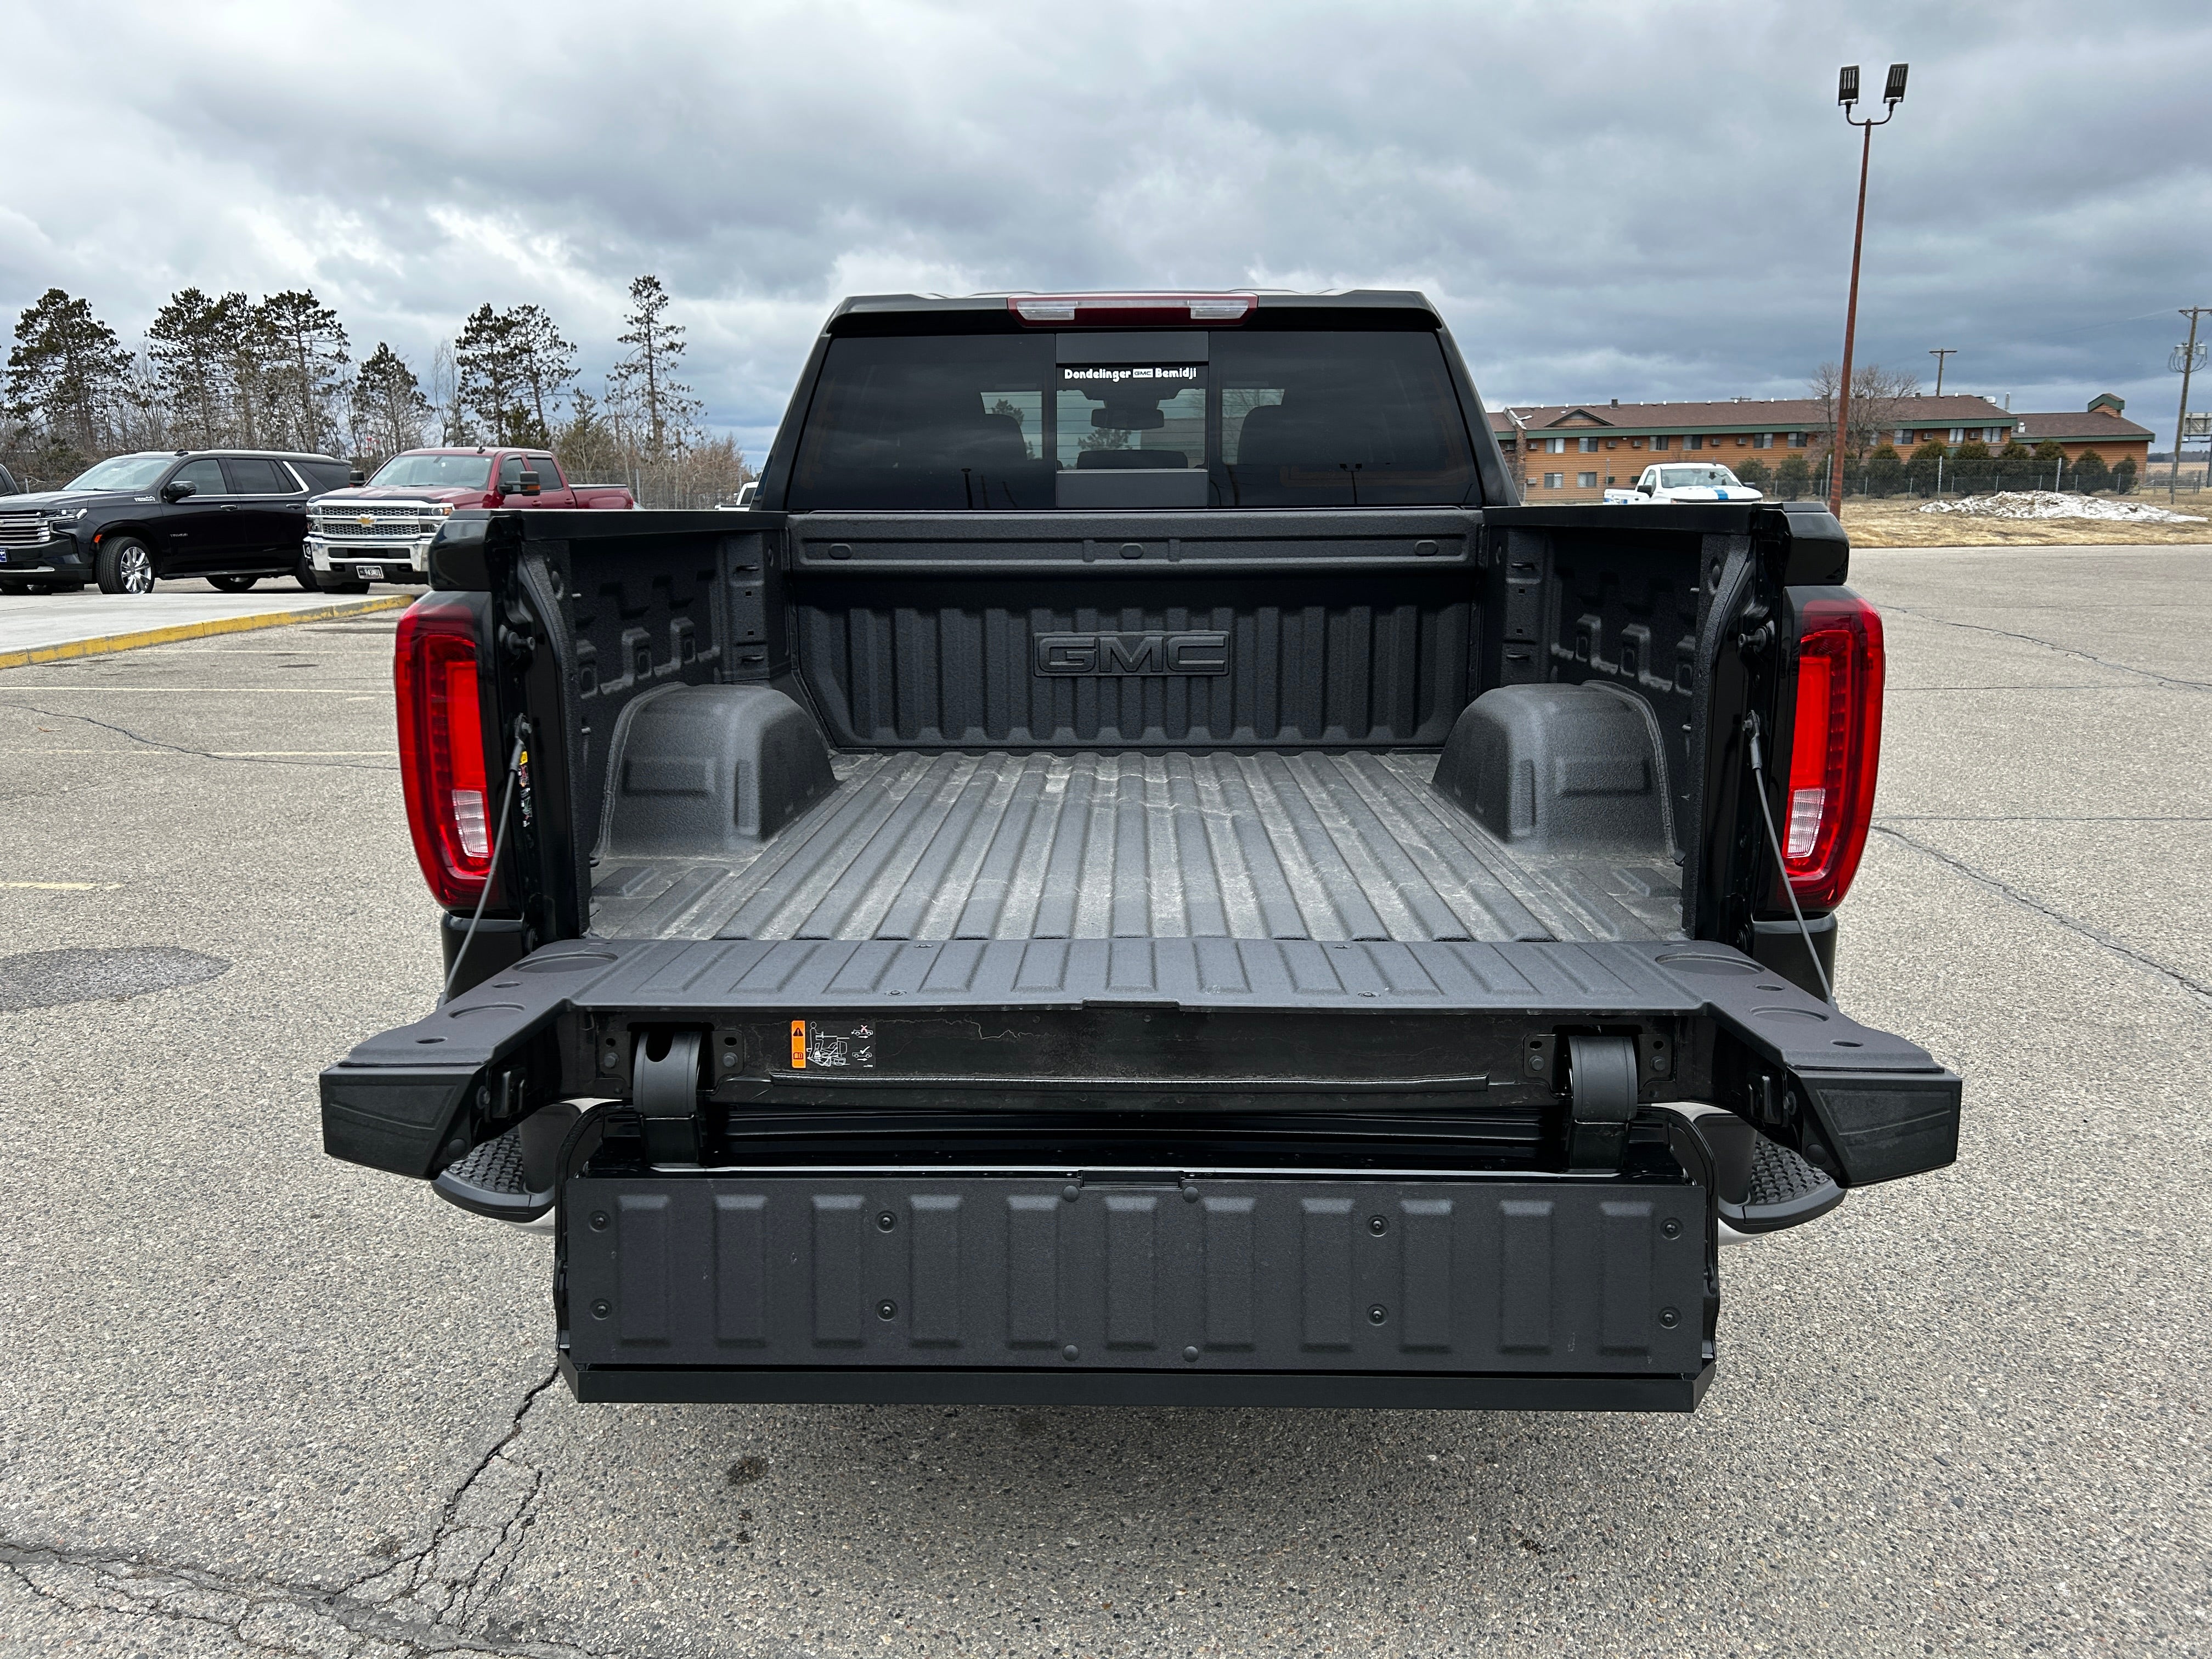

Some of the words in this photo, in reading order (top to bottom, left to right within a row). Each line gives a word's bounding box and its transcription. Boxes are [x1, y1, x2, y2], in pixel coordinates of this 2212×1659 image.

[1064, 368, 1131, 382] Dondelinger
[1155, 368, 1197, 380] Bemidji
[1038, 635, 1226, 673] GMC
